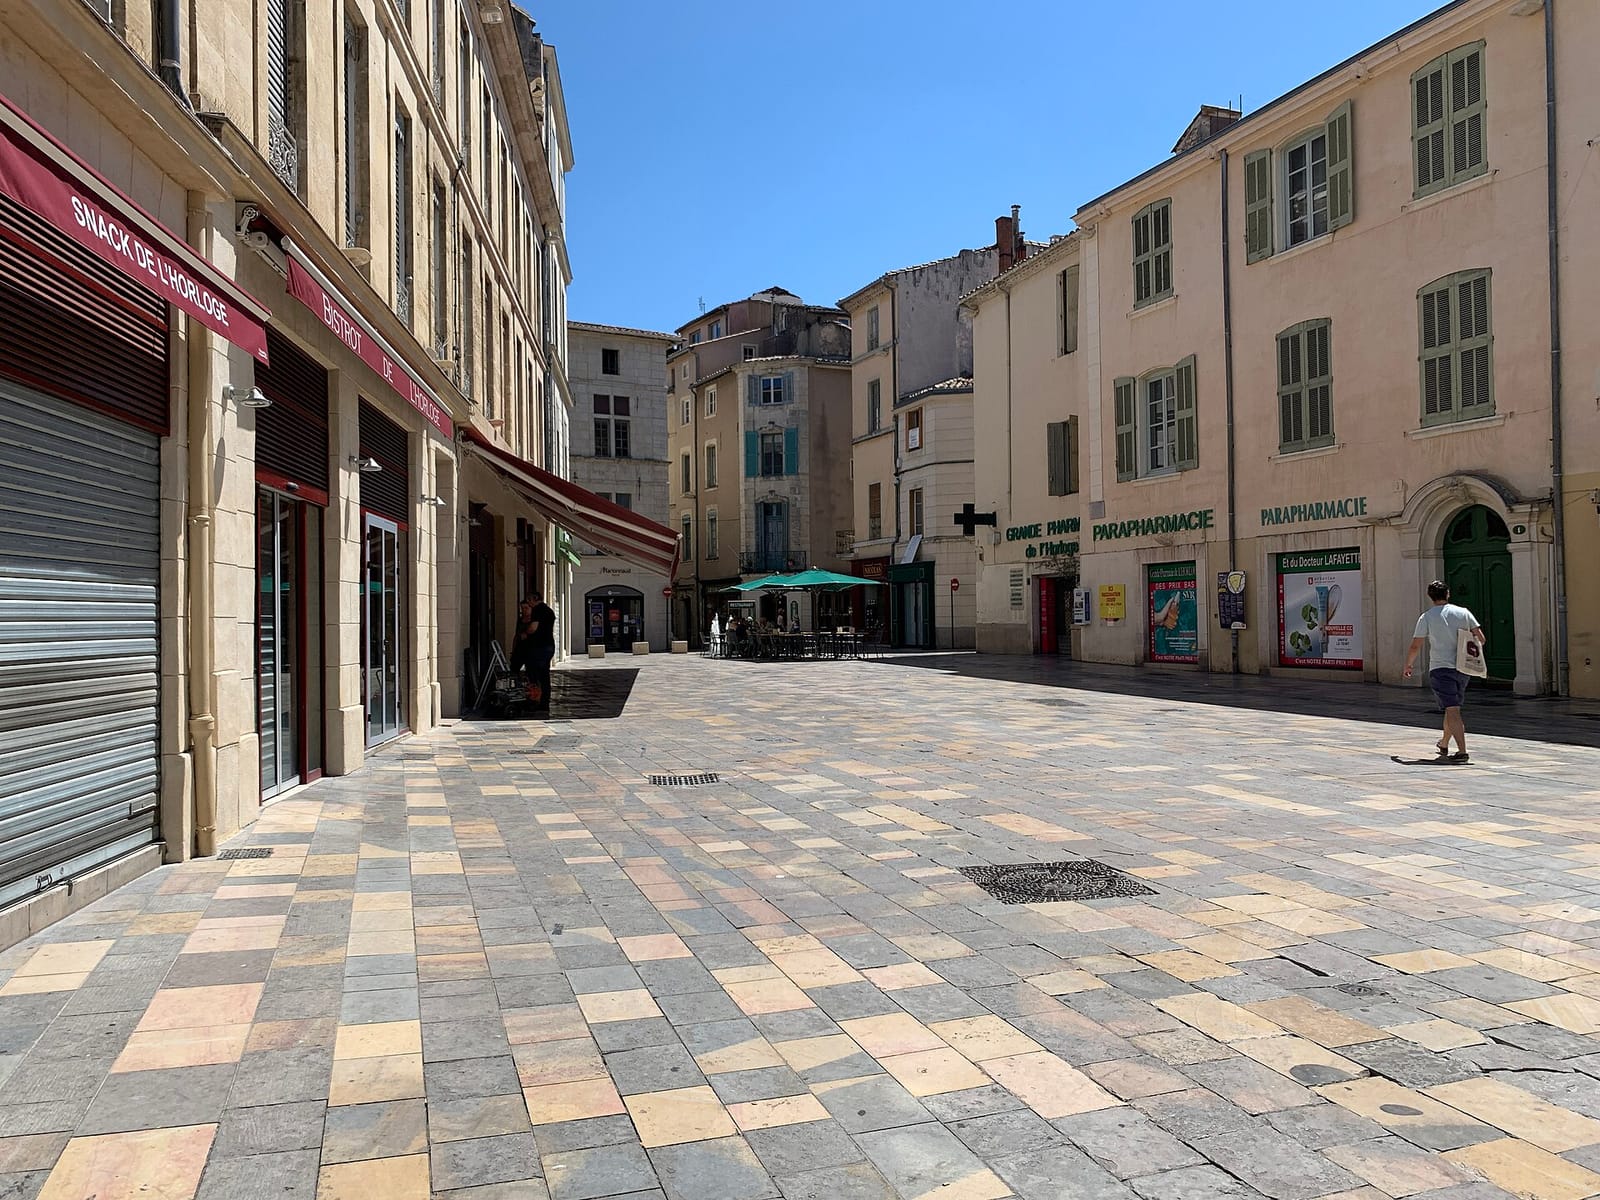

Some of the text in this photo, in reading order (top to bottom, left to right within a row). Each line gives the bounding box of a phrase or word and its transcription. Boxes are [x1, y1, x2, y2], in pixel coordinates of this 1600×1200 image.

[71, 195, 229, 327] SNACK DE L'HORLOGE
[322, 293, 441, 427] BISTROT DE L'HORLOGE
[1261, 497, 1368, 526] PARAPHARMACIE
[1006, 523, 1043, 541] GRANDE
[1092, 509, 1214, 541] PARAPHARMACIE
[1025, 540, 1080, 558] de l'Horloge
[1282, 557, 1289, 568] Et
[1289, 556, 1299, 568] du
[1299, 556, 1323, 567] Docteur
[1183, 581, 1195, 589] BAS
